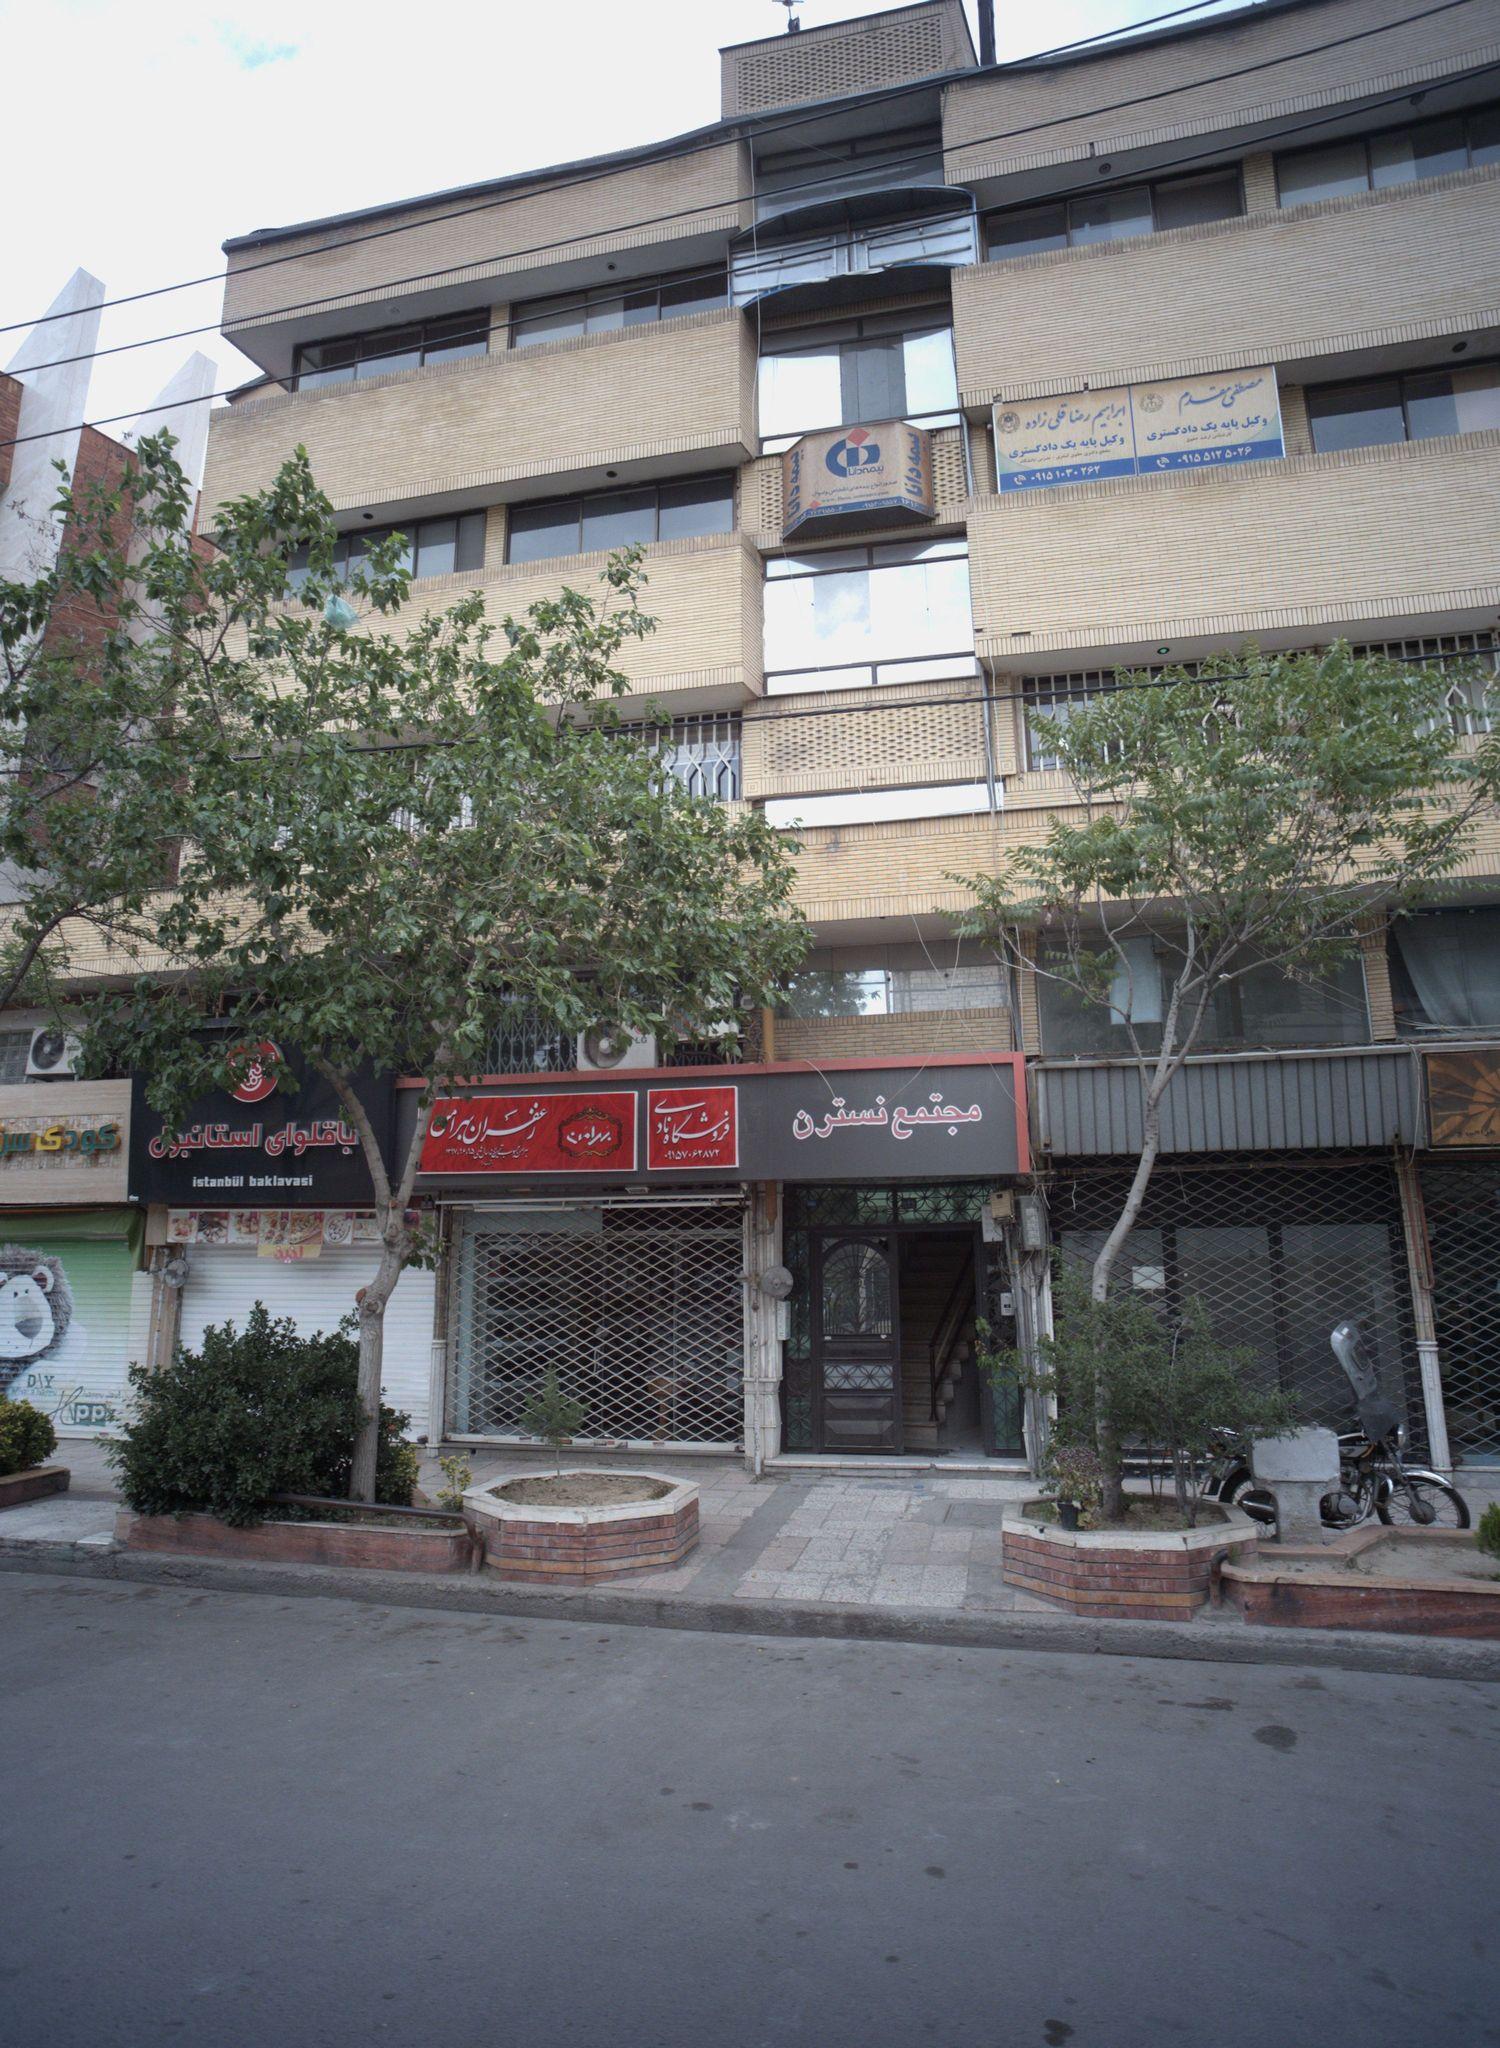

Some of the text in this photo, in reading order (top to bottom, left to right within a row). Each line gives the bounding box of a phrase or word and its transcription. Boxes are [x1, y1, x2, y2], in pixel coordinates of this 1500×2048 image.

[1069, 408, 1091, 424] رضا
[1178, 385, 1232, 417] مقدم
[1091, 403, 1126, 435] ابراهیم
[1146, 414, 1268, 442] وکیل پایه یک دادگستری
[1008, 433, 1125, 460] وکیل پایه یک دادگستری
[1177, 452, 1201, 464] ۰۹۱۵
[1030, 471, 1054, 481] ۰۹۱۵
[462, 1102, 549, 1145] زعفران
[662, 1109, 730, 1144] فروشگاه
[792, 1092, 983, 1140] مجتمع نسترن
[35, 1122, 120, 1156] کودک
[148, 1120, 358, 1159] باقلوای استانبول
[192, 1174, 314, 1188] istanbül baklavasi
